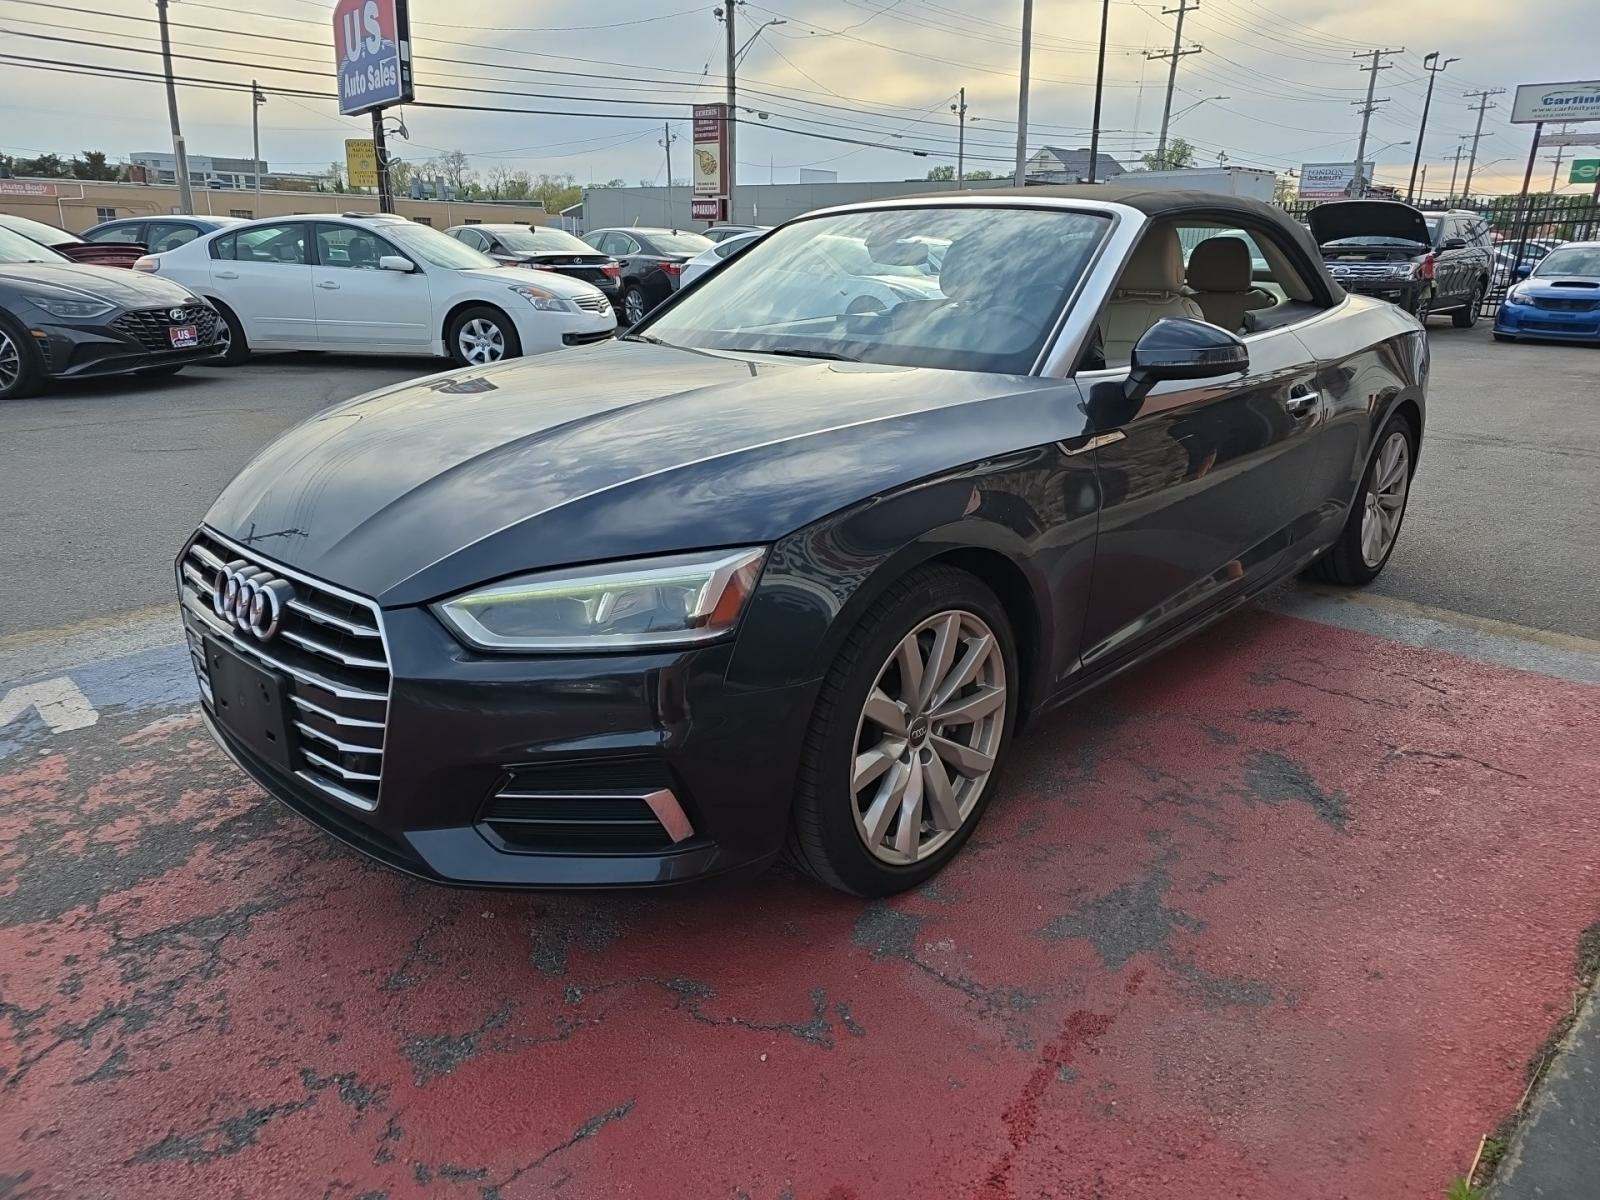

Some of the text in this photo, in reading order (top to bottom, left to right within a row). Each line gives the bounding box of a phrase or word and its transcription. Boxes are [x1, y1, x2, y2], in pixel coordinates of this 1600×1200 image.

[344, 60, 397, 98] Auto Sales
[2, 182, 24, 190] Auto
[25, 183, 48, 193] Body
